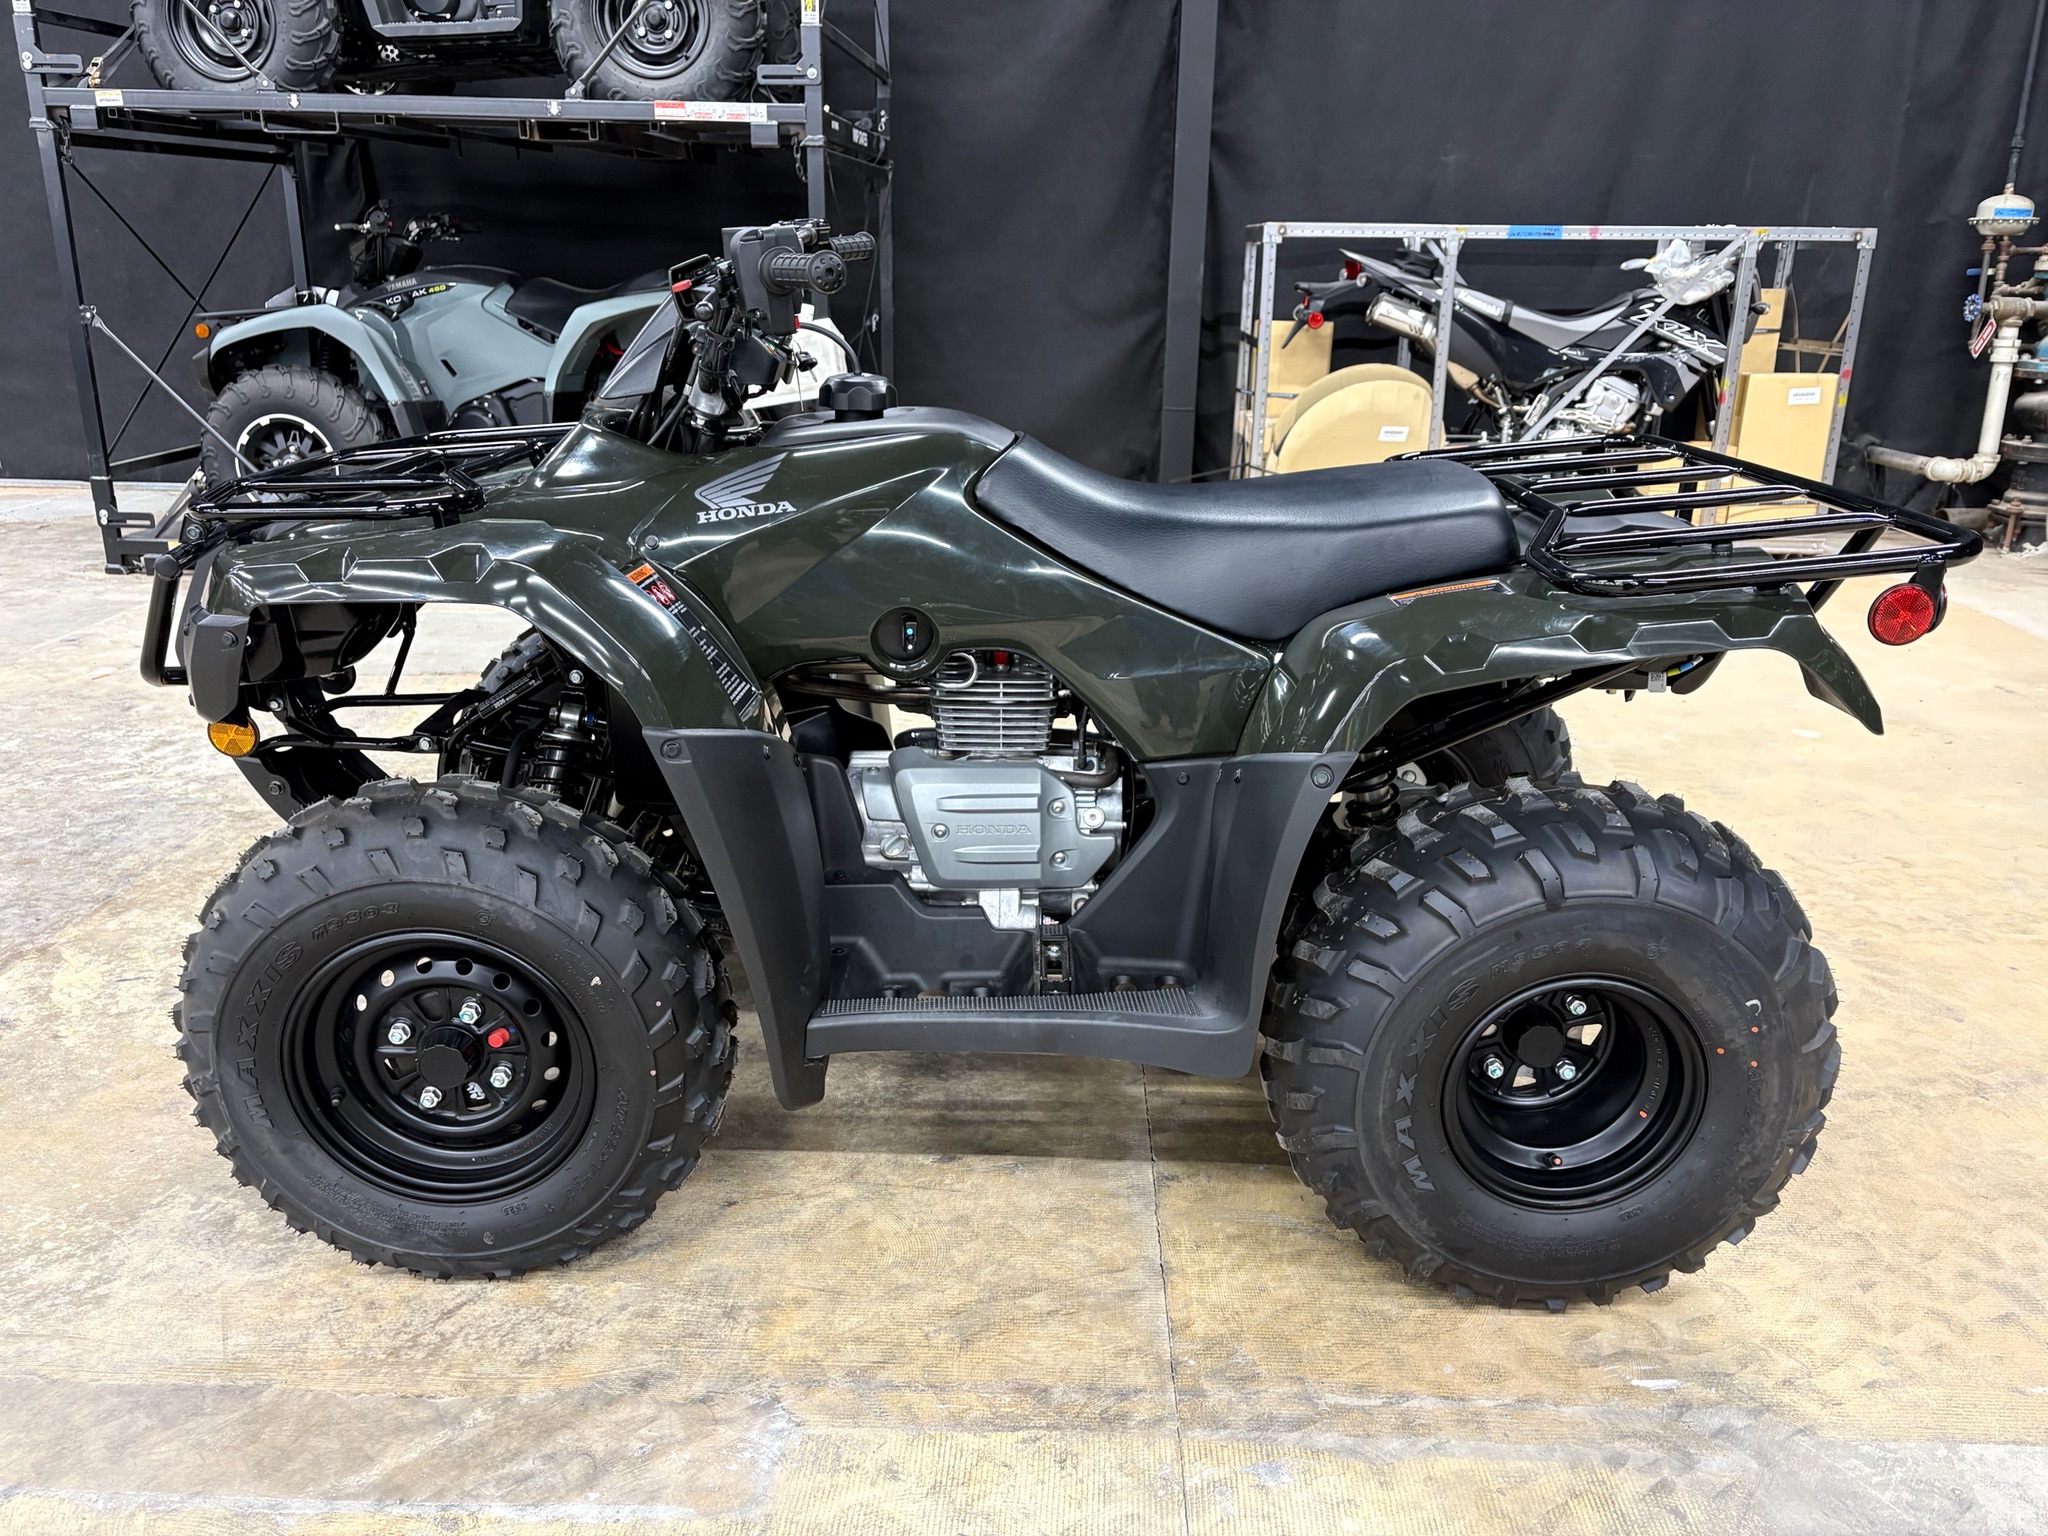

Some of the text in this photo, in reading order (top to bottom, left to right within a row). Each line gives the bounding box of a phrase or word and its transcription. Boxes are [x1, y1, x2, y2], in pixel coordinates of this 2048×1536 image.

[386, 277, 418, 292] YAMAHA
[385, 287, 428, 306] KOAK
[696, 500, 798, 525] HONDA
[955, 823, 1033, 837] HONDA
[233, 941, 304, 1131] MAXXIS
[1389, 974, 1481, 1193] MAXXIS
